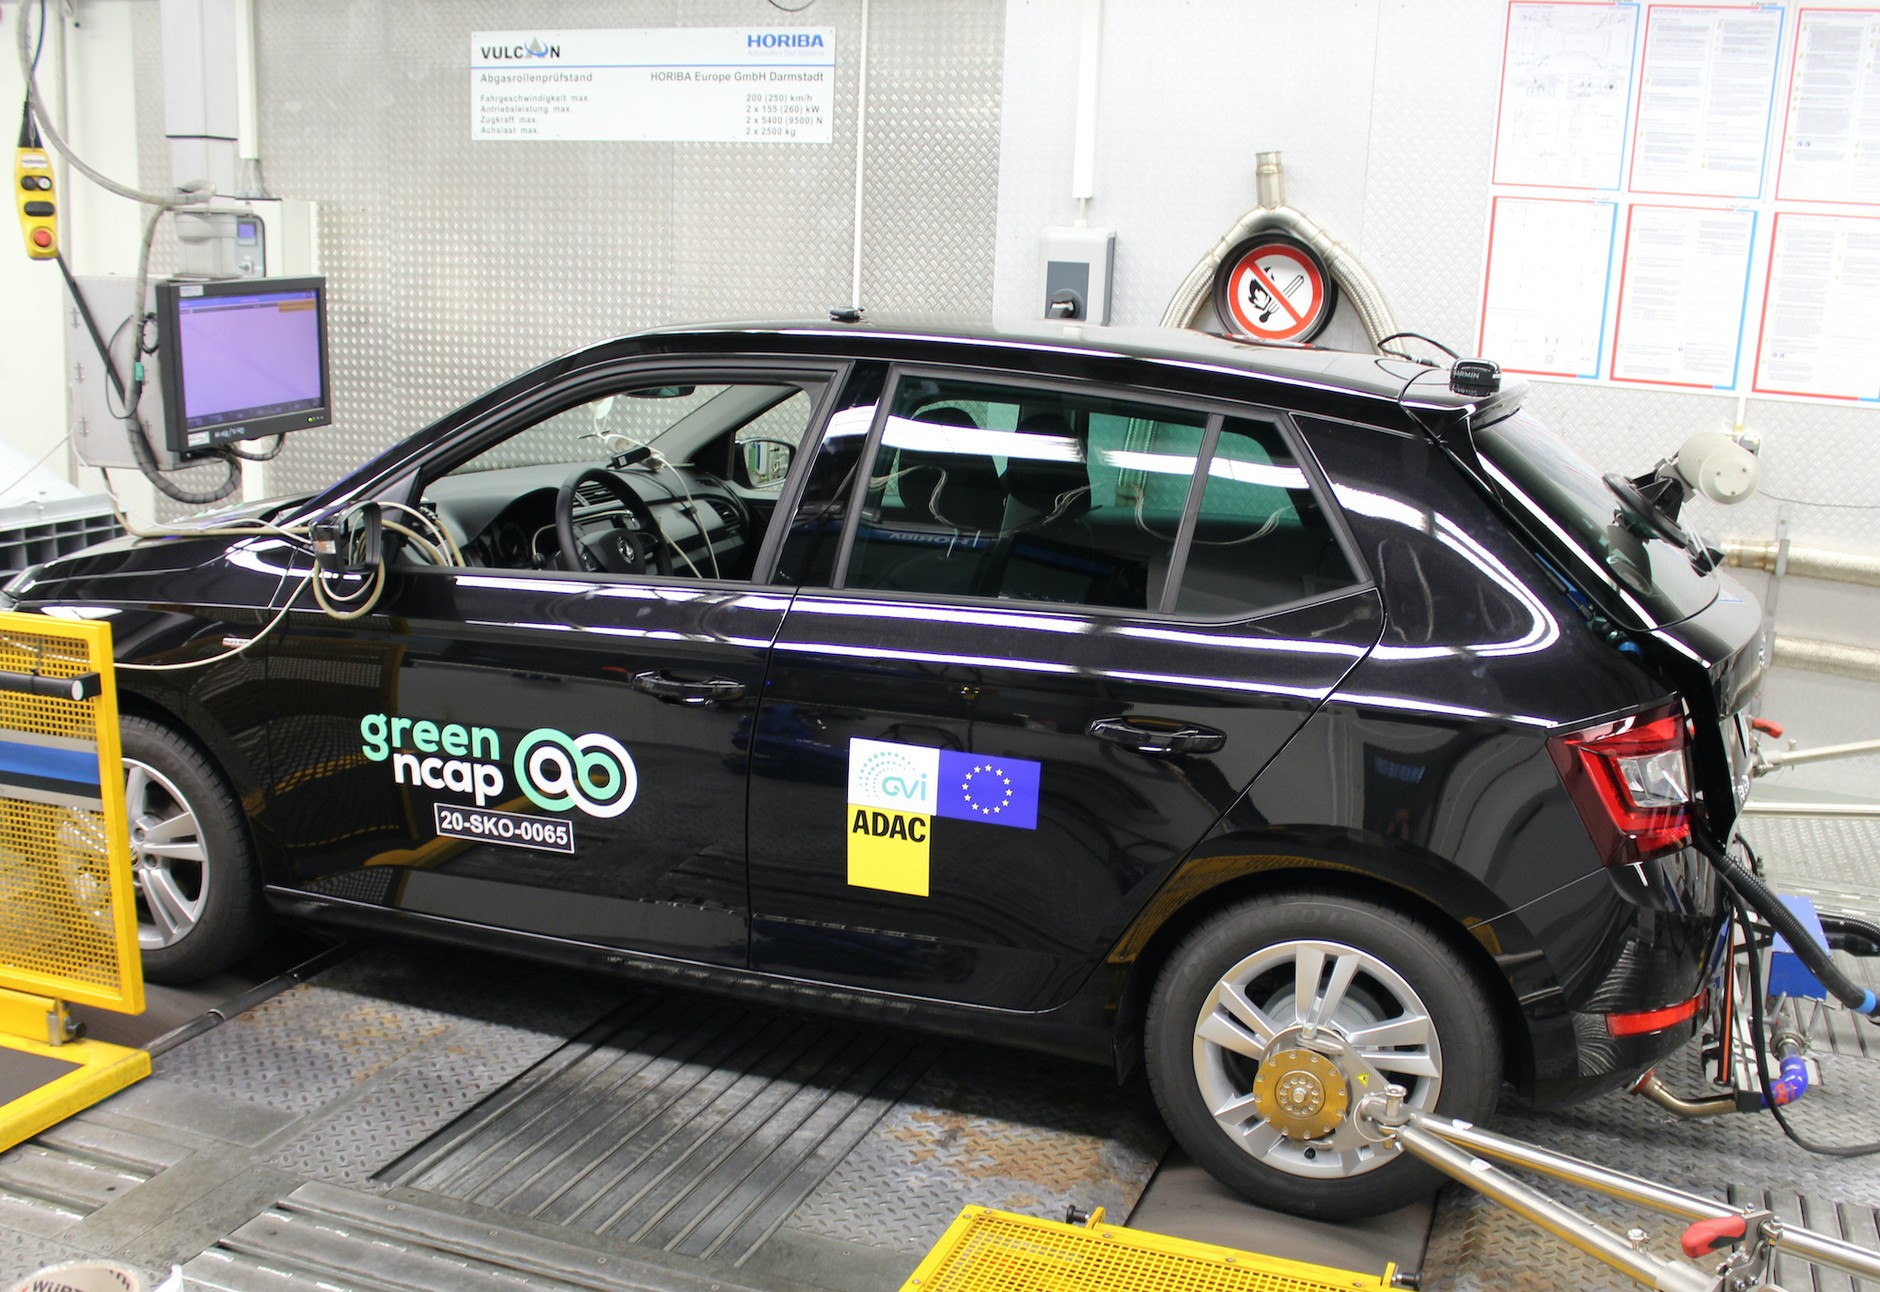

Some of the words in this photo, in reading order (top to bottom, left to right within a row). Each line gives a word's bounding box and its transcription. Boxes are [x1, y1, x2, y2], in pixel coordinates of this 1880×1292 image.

[747, 33, 824, 48] HORIBA
[480, 72, 593, 84] Abgasrollenprüfstand
[650, 72, 692, 82] HORIBA
[695, 72, 731, 84] Europe
[734, 72, 766, 82] GmbH
[769, 72, 824, 82] Darmstadt
[480, 94, 567, 104] Fahrgeschwindigkeit
[746, 94, 762, 102] 200
[765, 94, 787, 103] (250)
[790, 94, 813, 102] km/h
[480, 105, 548, 114] Antriebsleistung
[746, 105, 751, 113] 2
[763, 105, 778, 113] 155
[806, 105, 820, 113] kW
[480, 116, 515, 125] Zugkraft
[746, 116, 751, 124] 2
[762, 116, 782, 124] 5400
[480, 126, 516, 134] Achslast
[746, 128, 751, 136] 2
[762, 128, 782, 136] 2500
[786, 128, 796, 138] kg
[360, 712, 500, 762] green
[392, 752, 504, 806] ncap
[440, 811, 569, 846] 20-SKO-0065
[852, 810, 926, 843] ADAC
